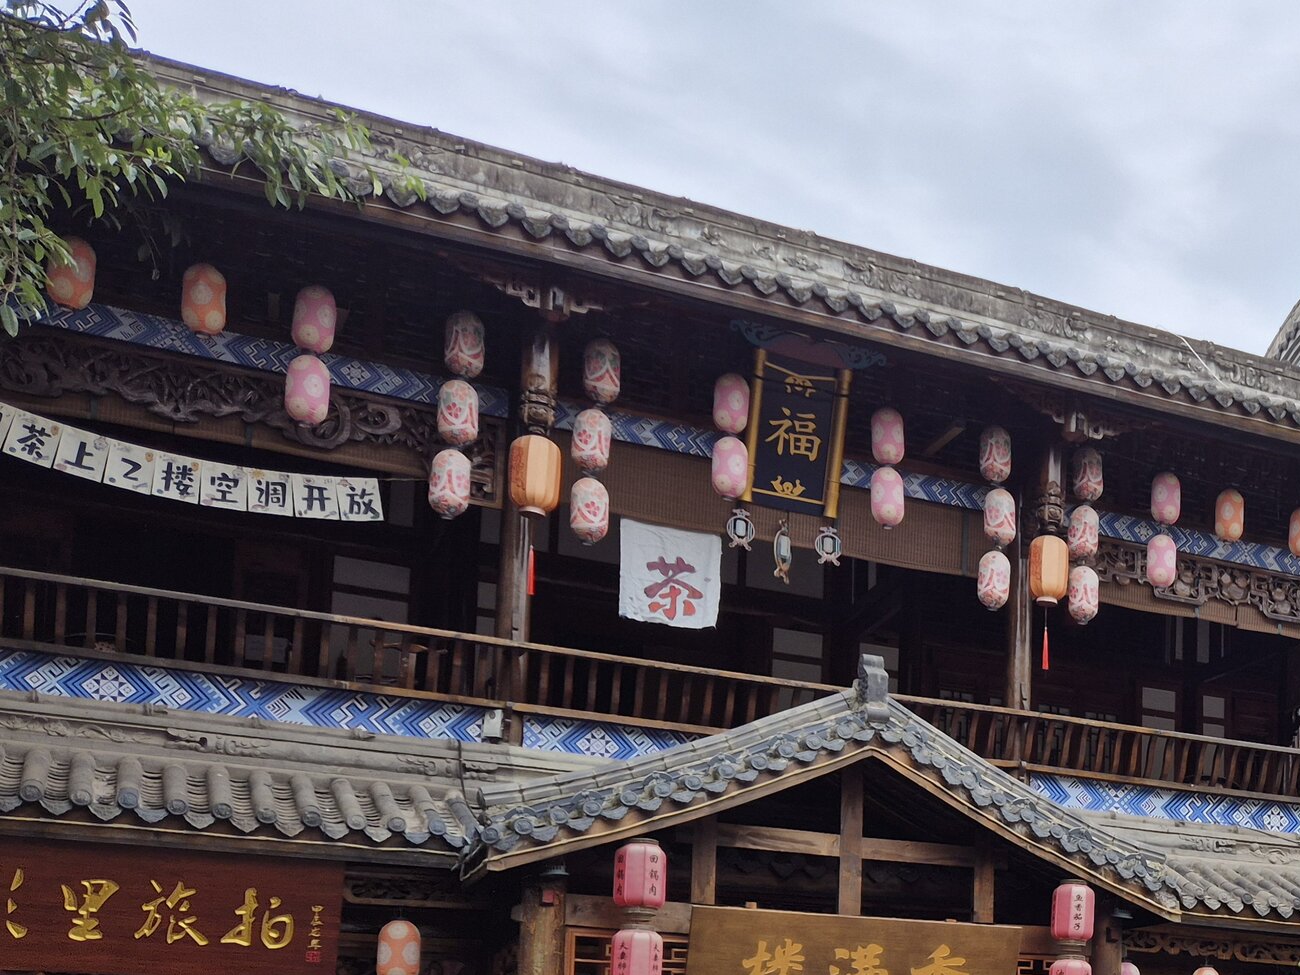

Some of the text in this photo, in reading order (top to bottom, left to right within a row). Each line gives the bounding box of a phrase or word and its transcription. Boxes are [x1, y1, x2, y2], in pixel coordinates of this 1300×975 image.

[765, 407, 822, 462] 福
[0, 412, 380, 519] 茶上2楼空调开放
[643, 555, 704, 620] 茶
[649, 854, 660, 897] 回锅肉
